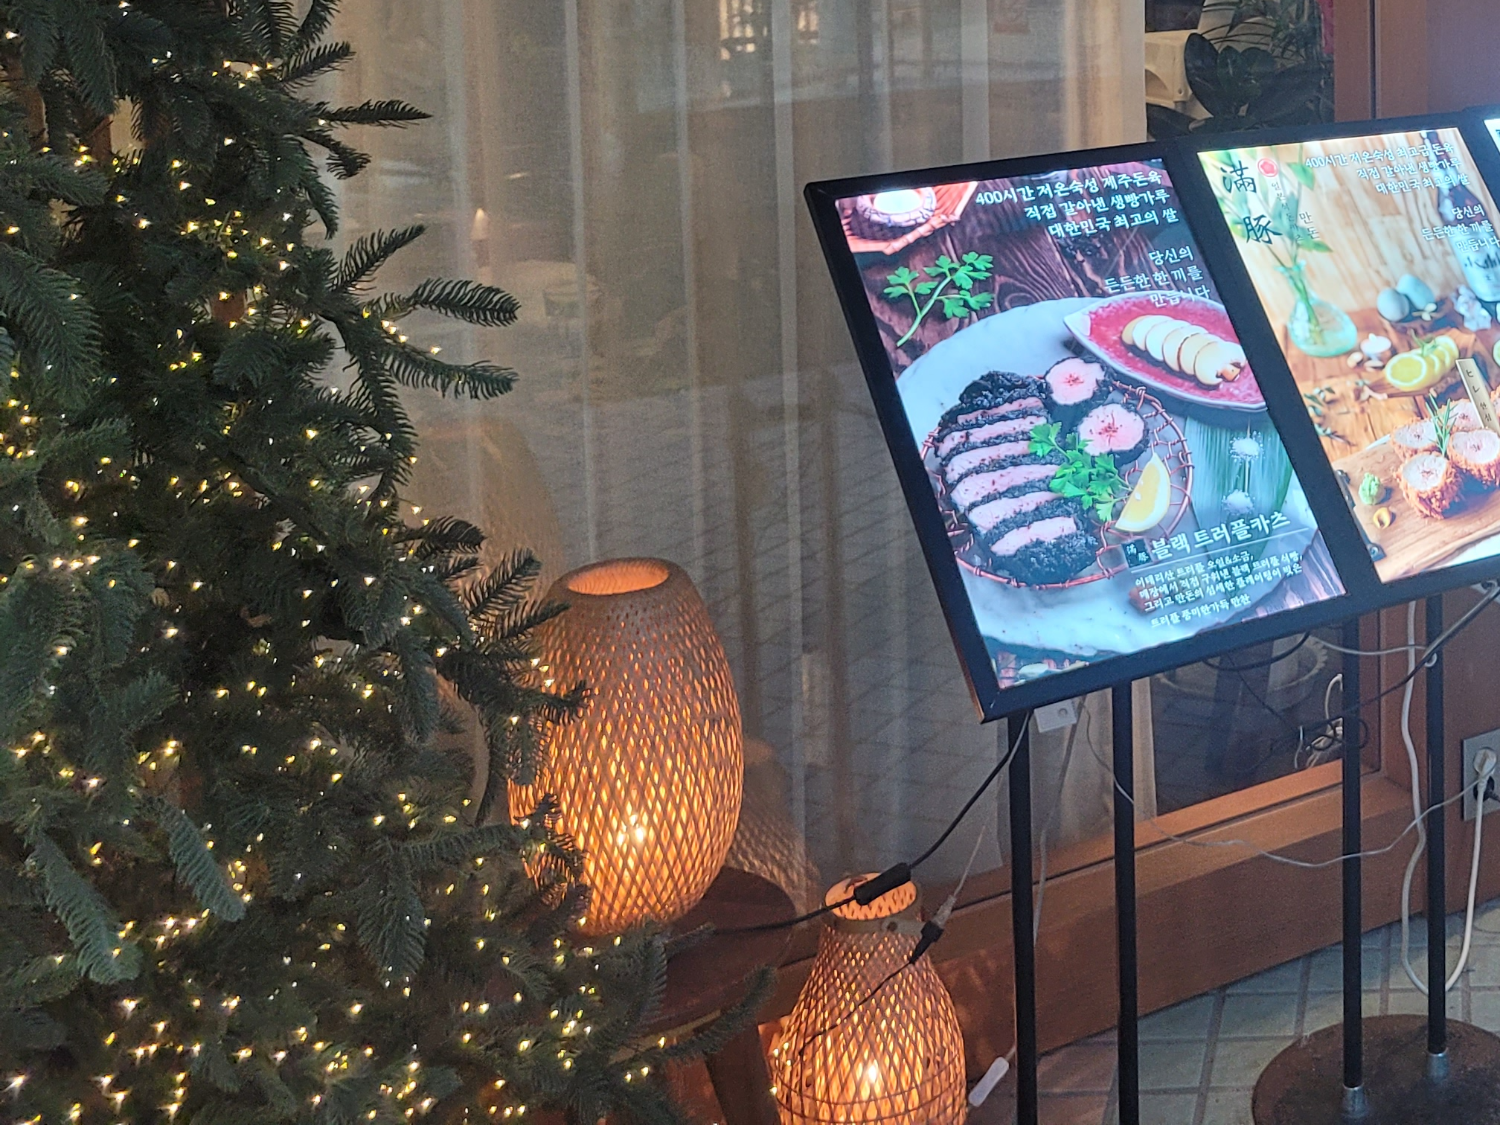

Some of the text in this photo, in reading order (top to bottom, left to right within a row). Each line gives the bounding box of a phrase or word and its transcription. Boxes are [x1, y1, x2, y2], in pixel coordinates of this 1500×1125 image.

[1305, 153, 1348, 168] 400시간
[1350, 150, 1395, 164] 저온숙성
[1357, 168, 1380, 181] 직접
[1383, 163, 1417, 177] 갈아낸
[975, 170, 1162, 205] 400시간 저온숙성 제주돈육
[1375, 178, 1420, 195] 대한민국
[1025, 188, 1170, 221] 직접 갈아낸 생빵가루
[1451, 204, 1485, 220] 당신의
[1048, 208, 1180, 237] 대한민국 최고의 쌀
[1422, 226, 1455, 241] 든든한
[1456, 236, 1500, 253] 만듭니다
[1149, 245, 1194, 266] 당신의
[1105, 265, 1203, 293] 든든한 한 끼를
[1150, 285, 1211, 308] 만듭니다
[1151, 511, 1290, 560] 블랙 트러플카츠
